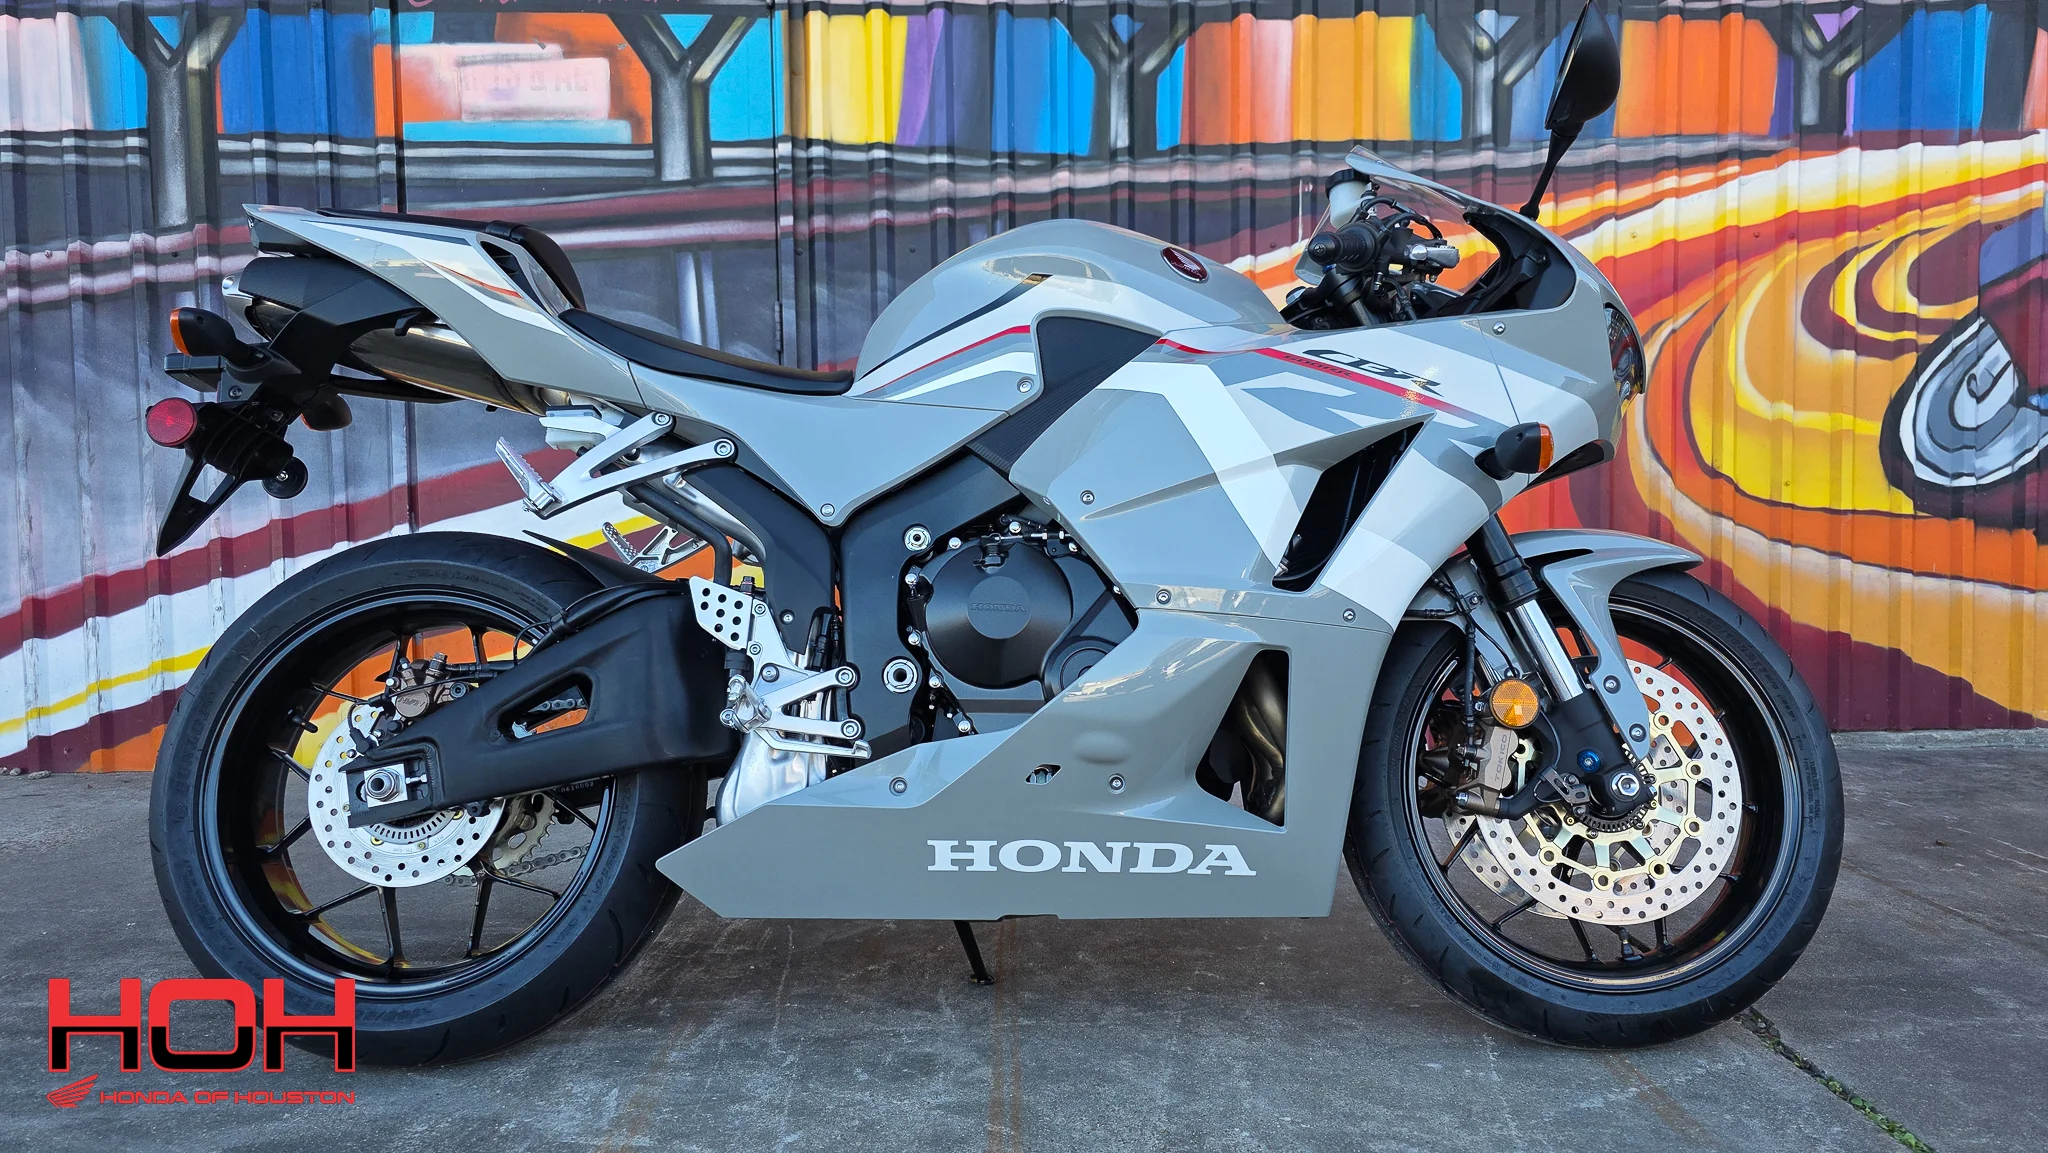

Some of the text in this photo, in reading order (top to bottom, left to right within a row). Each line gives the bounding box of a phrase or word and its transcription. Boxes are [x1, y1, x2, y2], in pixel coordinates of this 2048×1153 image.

[1284, 354, 1352, 377] 600RR
[1302, 349, 1443, 397] CBR
[970, 602, 1027, 612] HONDA
[1494, 734, 1507, 782] TOKICO
[927, 839, 1256, 876] HONDA
